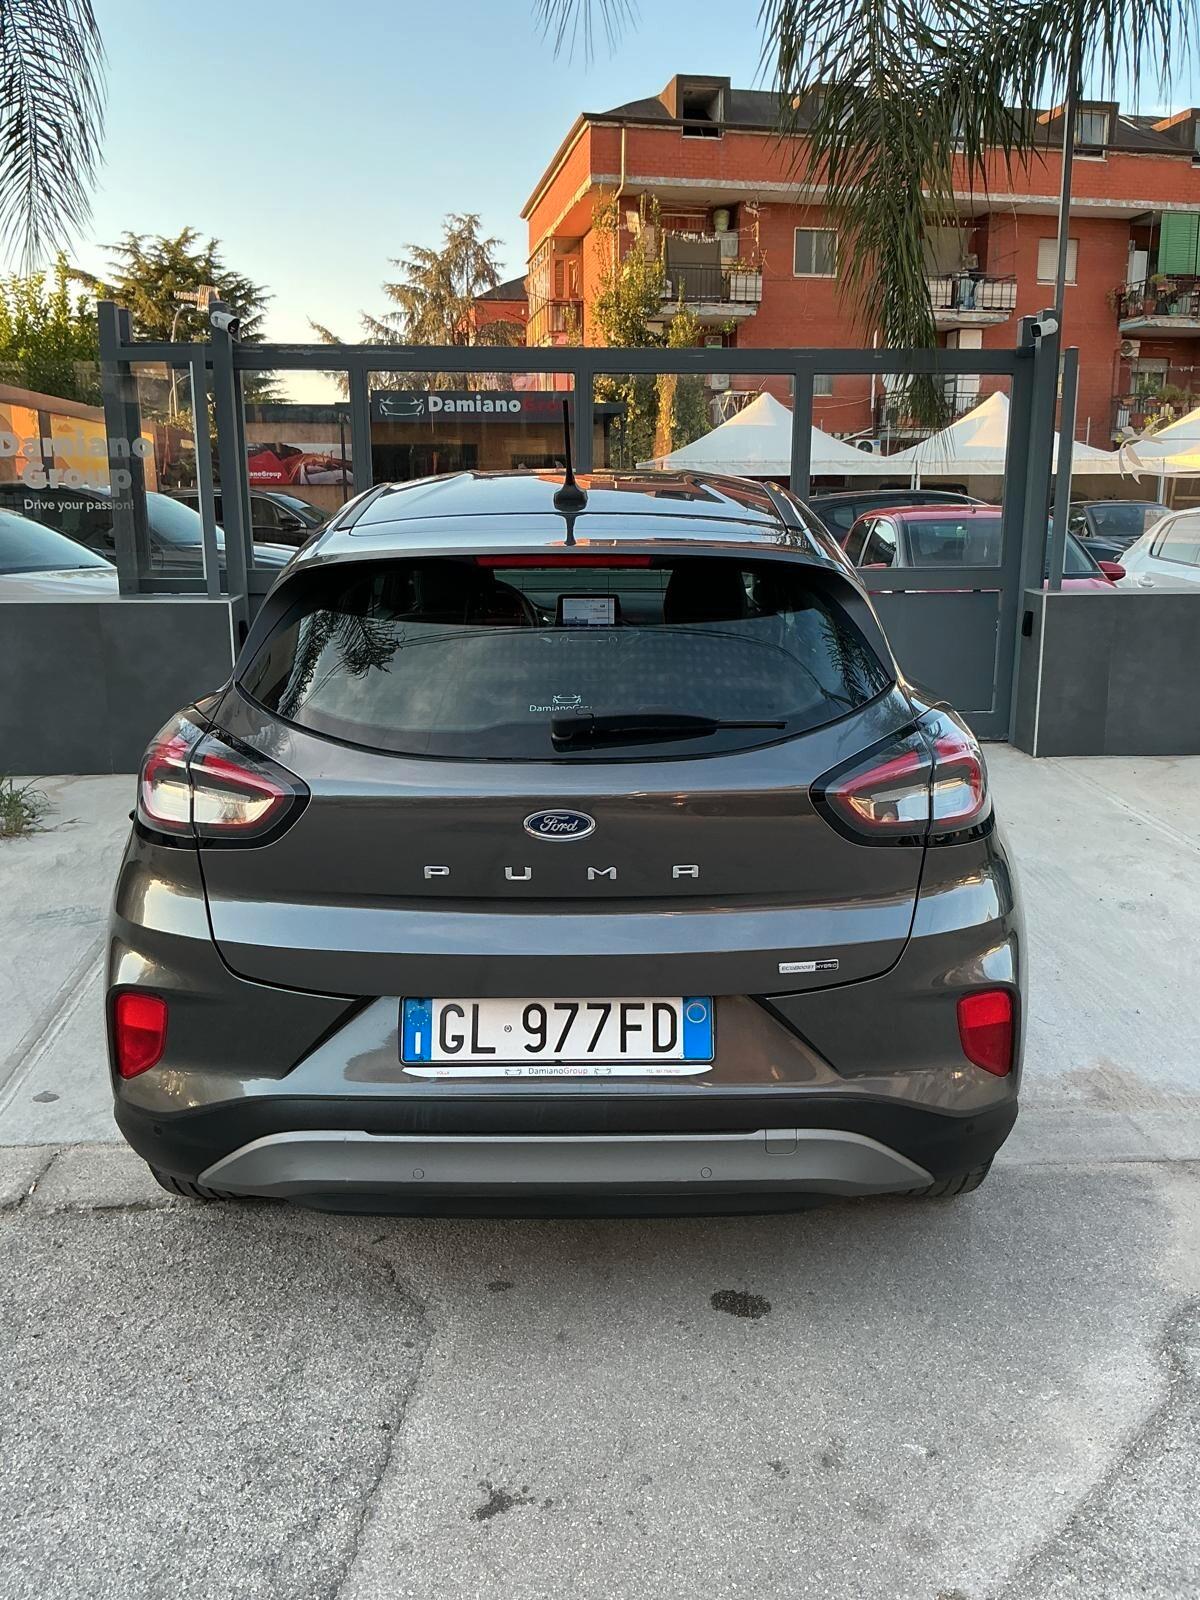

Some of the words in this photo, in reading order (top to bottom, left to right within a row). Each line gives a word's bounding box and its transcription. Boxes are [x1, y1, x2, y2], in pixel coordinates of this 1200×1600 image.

[0, 428, 154, 458] Damiano
[23, 462, 133, 498] Group
[24, 499, 55, 510] Drive
[58, 502, 84, 513] your
[540, 815, 579, 831] Ford
[424, 864, 699, 881] PUMA
[528, 1067, 588, 1075] DamianoGroup
